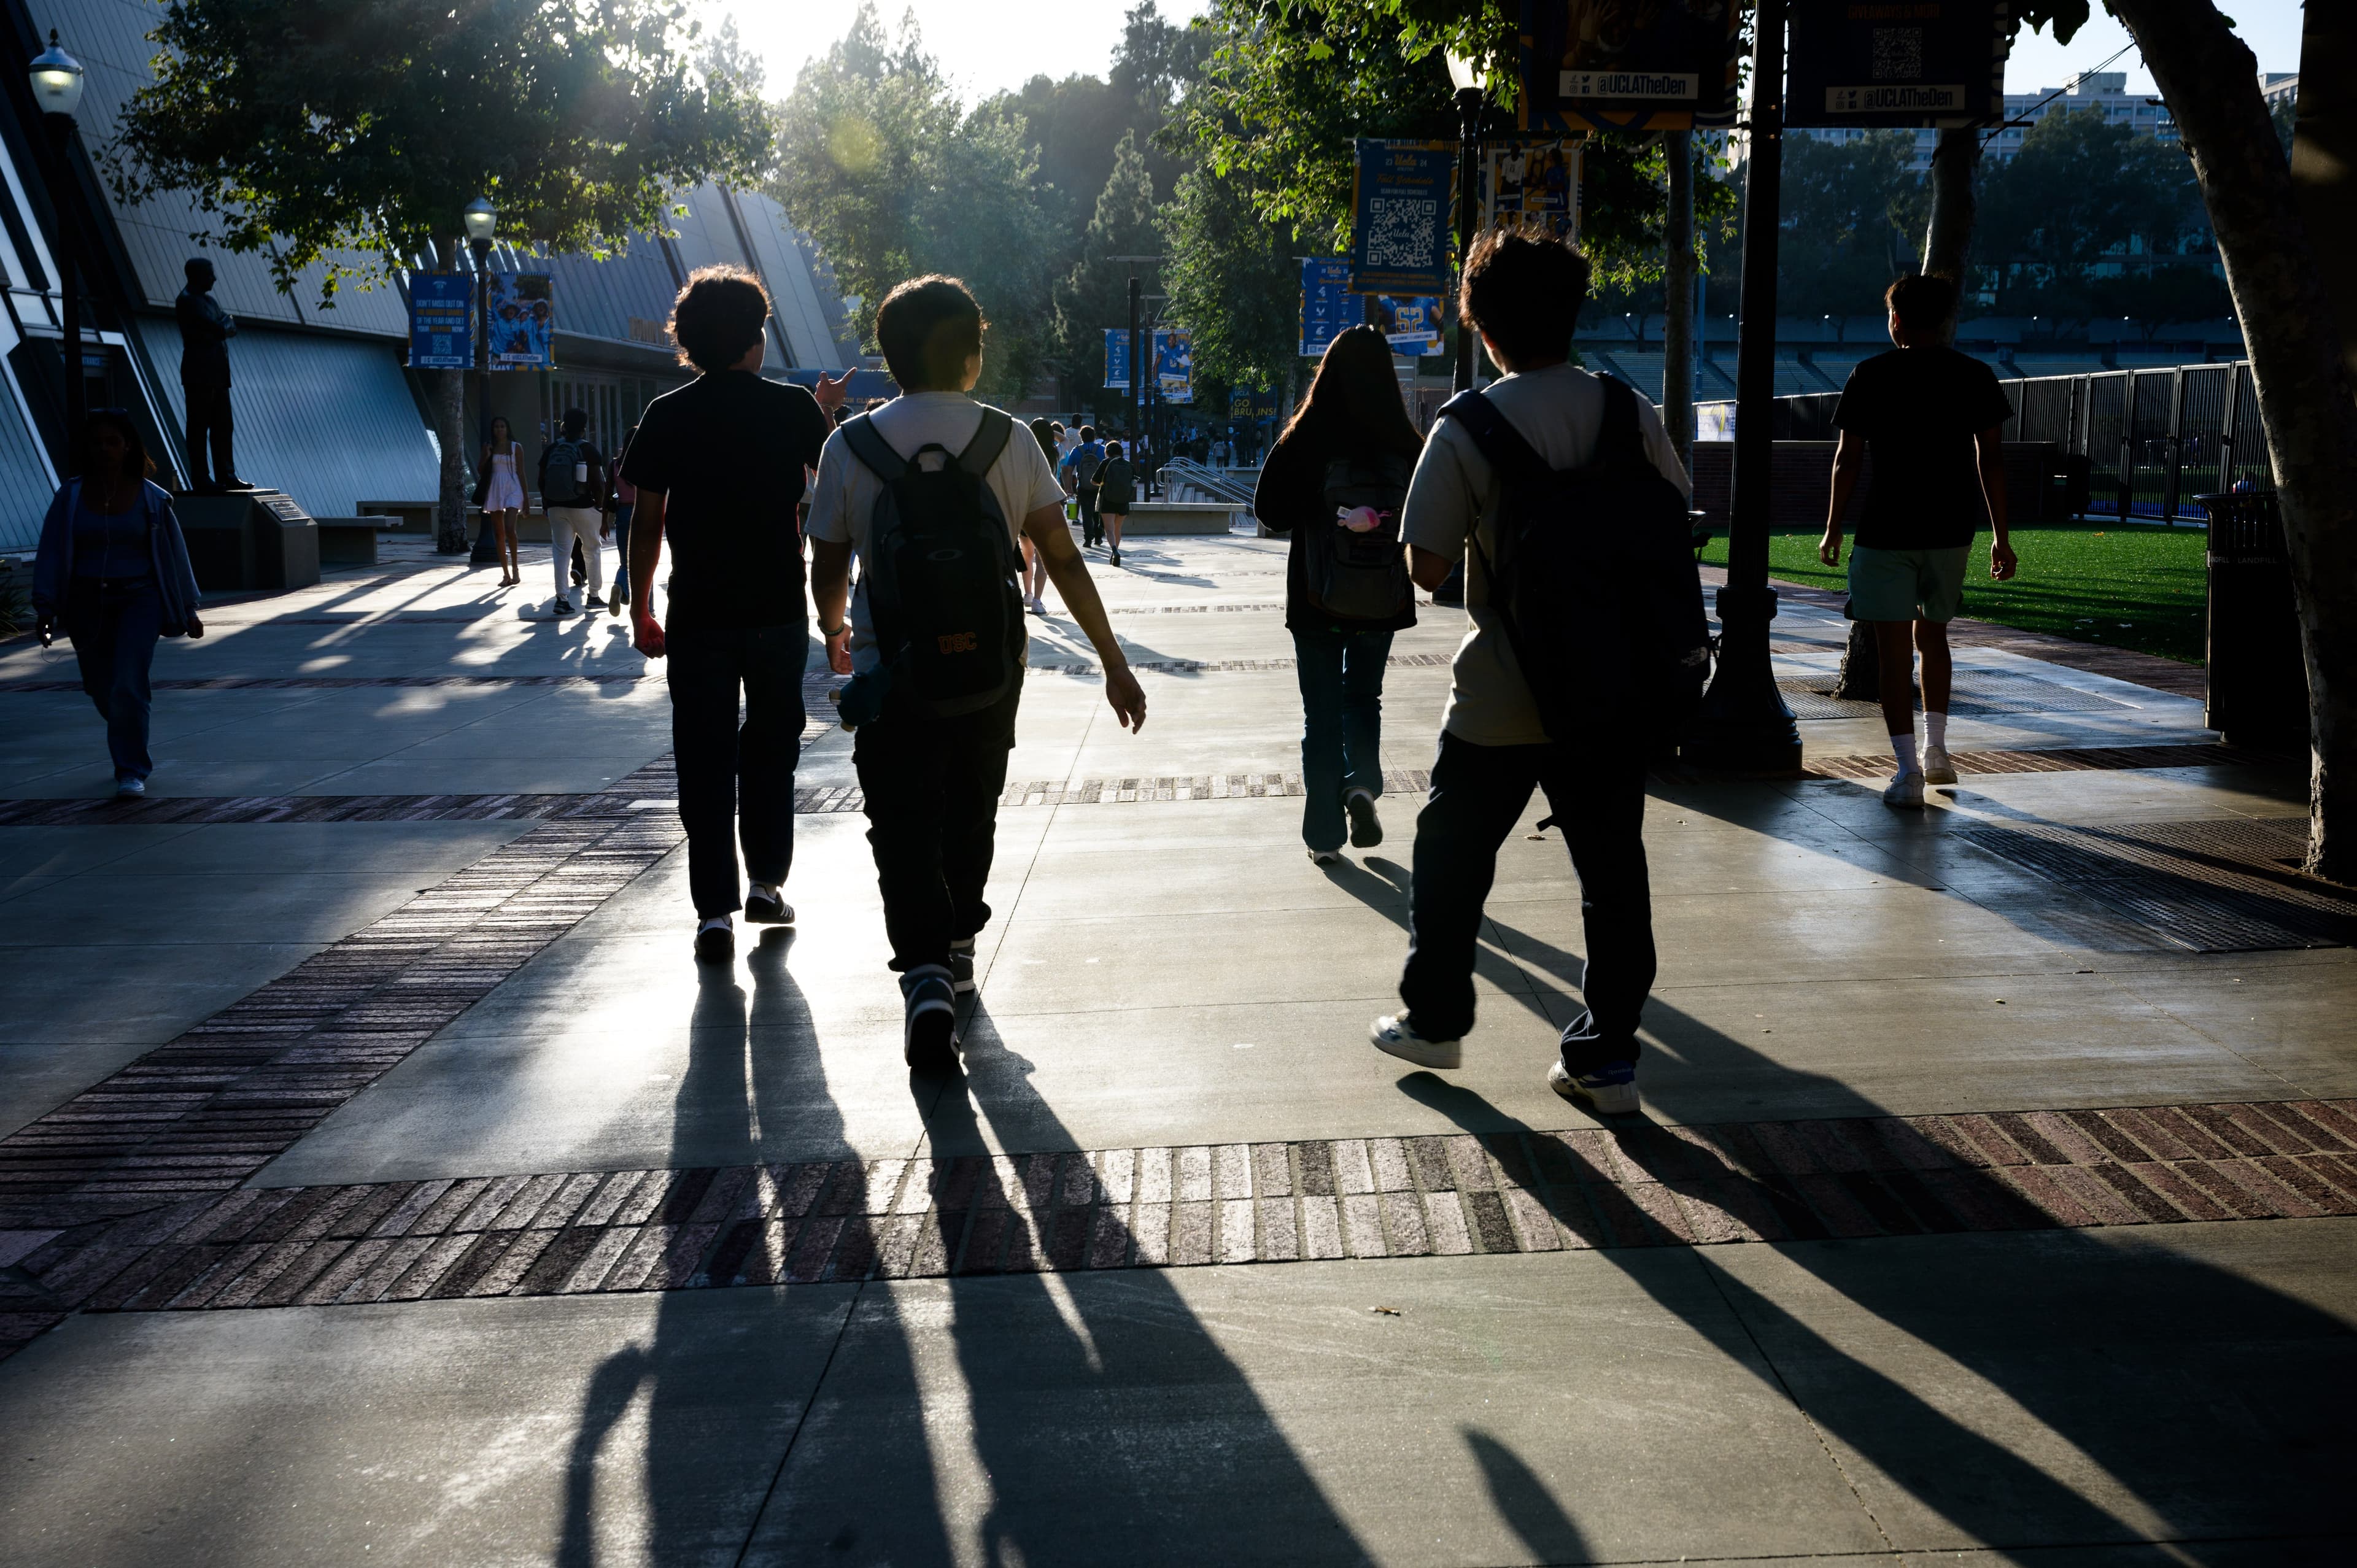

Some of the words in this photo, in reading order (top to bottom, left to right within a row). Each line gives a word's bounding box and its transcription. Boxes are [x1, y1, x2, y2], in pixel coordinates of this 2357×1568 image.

[1848, 4, 1902, 20] GIVEAWAYS
[1598, 75, 1686, 95] @UCLATheDen
[1864, 88, 1953, 109] @UCLATheDen
[1395, 153, 1417, 166] Ucla
[1420, 158, 1428, 168] 24
[1395, 307, 1423, 333] 62
[1234, 398, 1250, 407] GO
[937, 631, 977, 655] USC
